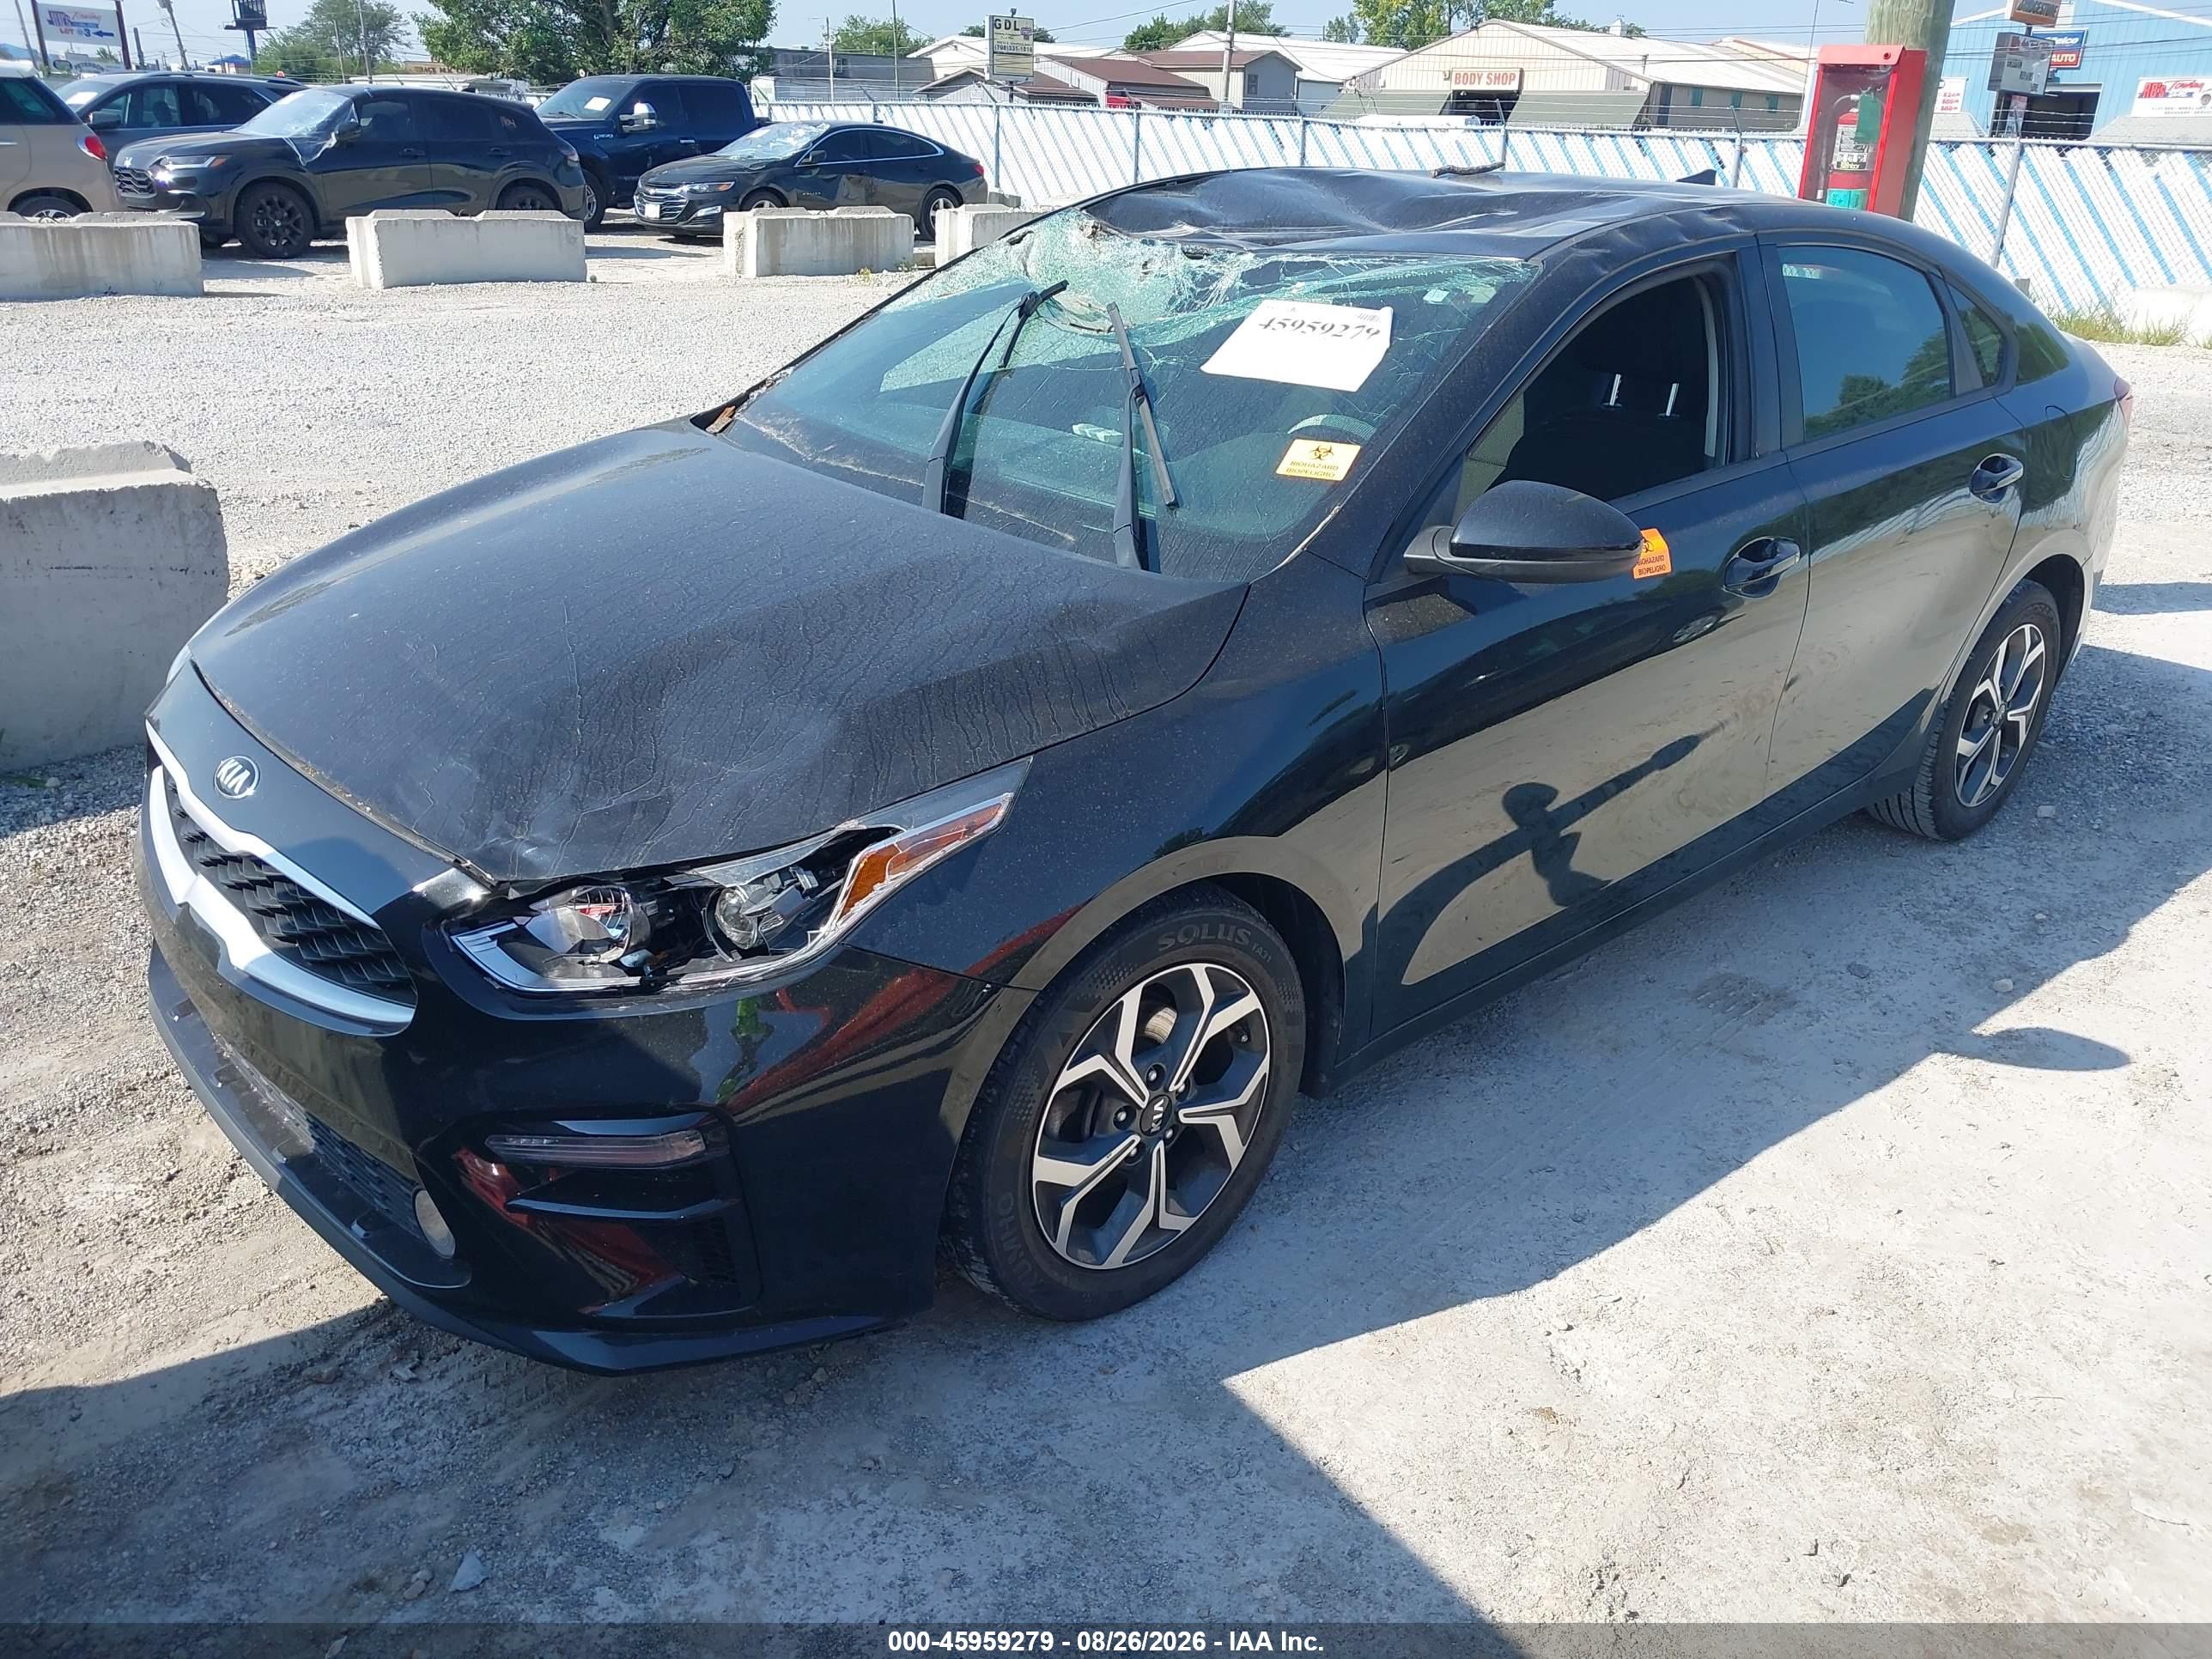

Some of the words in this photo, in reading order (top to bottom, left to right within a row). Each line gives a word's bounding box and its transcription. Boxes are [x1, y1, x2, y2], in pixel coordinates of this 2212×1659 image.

[2051, 53, 2075, 63] AUTO
[1455, 72, 1483, 85] BODY
[1486, 72, 1516, 85] SHOP
[1258, 317, 1381, 340] 45959279
[1290, 460, 1339, 471] BIOHAZARD
[1285, 467, 1336, 477] BIOPELIGRO
[1638, 564, 1667, 576] BIOPELIGRO
[1158, 923, 1251, 952] SOLUS
